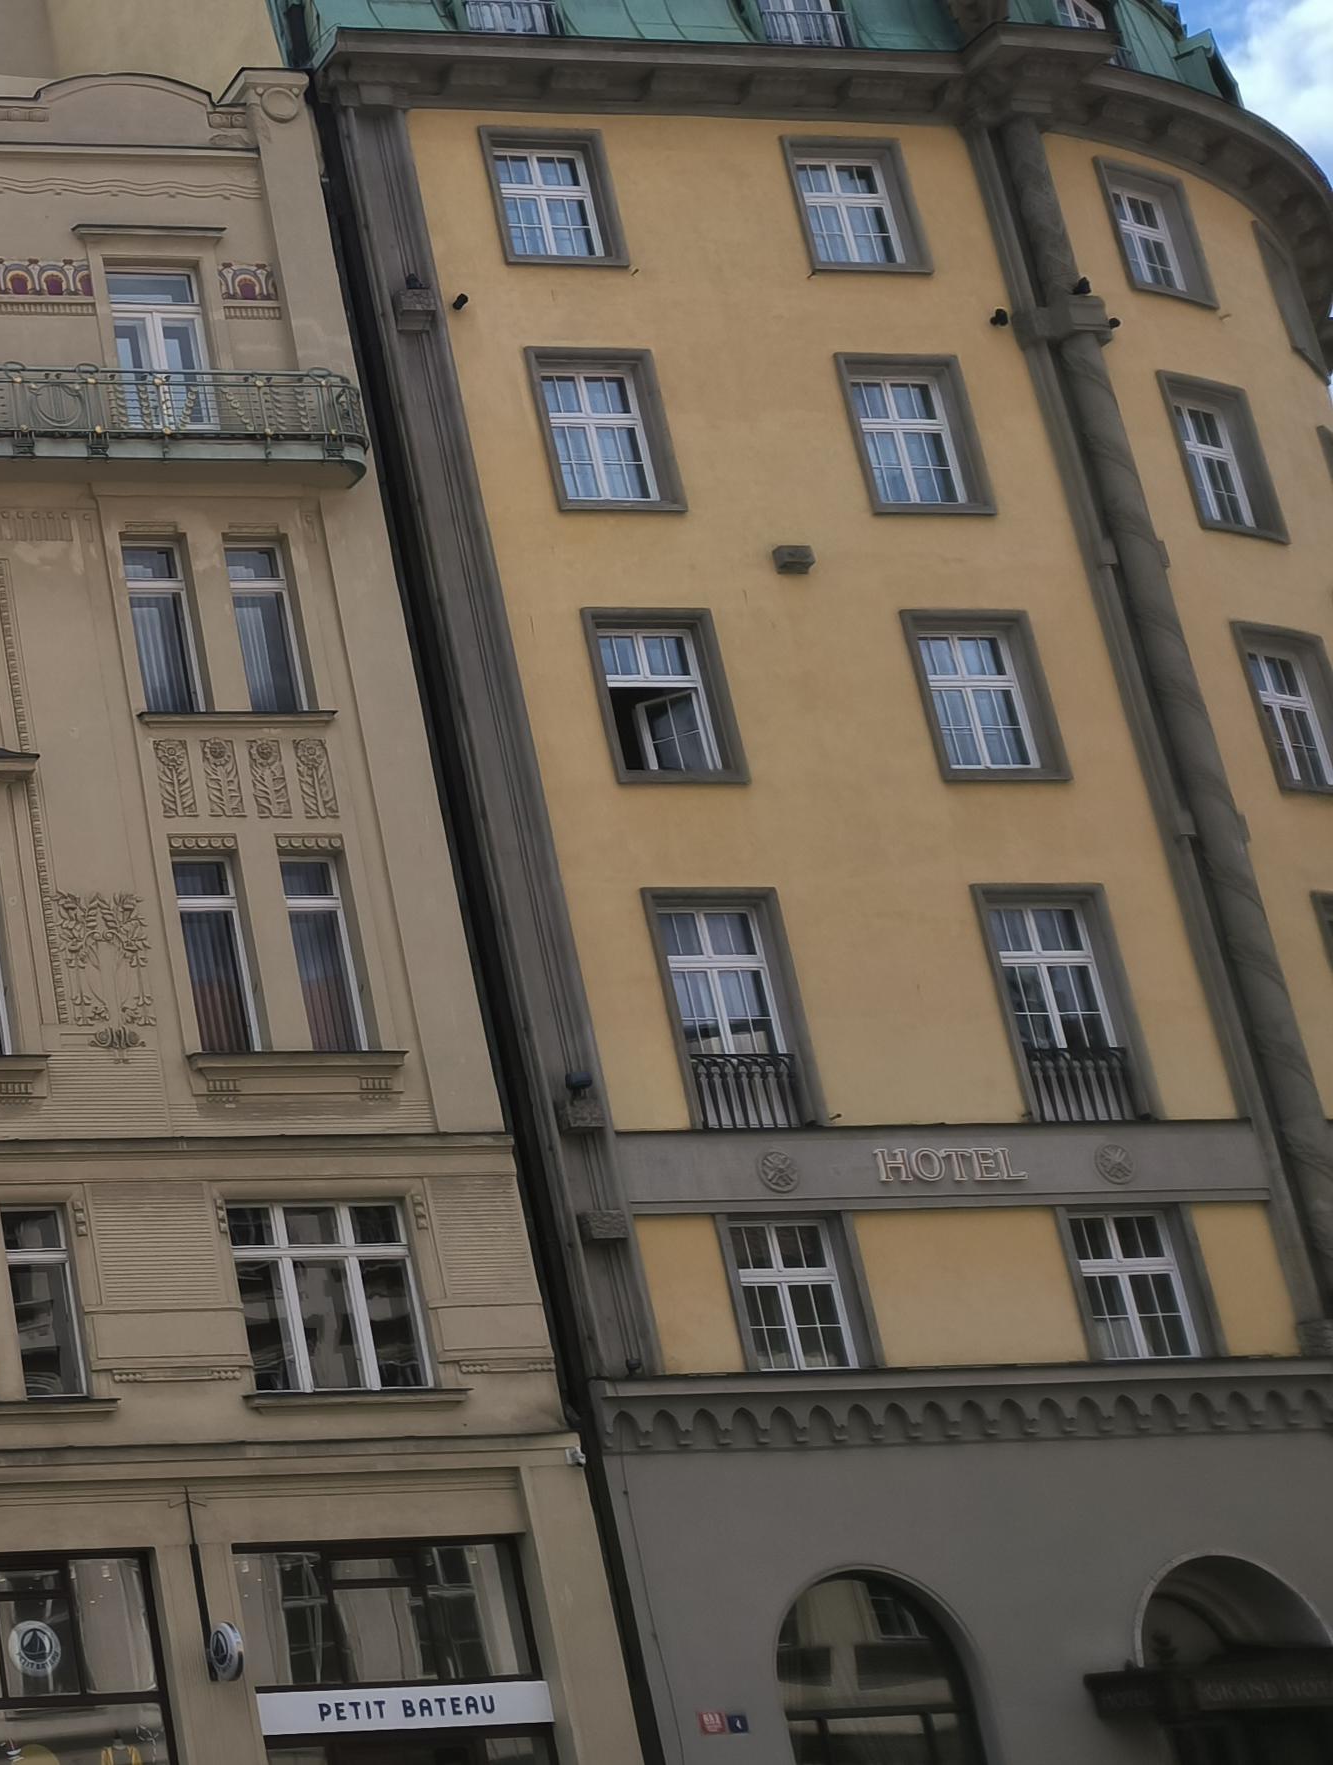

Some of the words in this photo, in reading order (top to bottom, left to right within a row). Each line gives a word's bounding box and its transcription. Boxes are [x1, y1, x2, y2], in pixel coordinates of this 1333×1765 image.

[873, 1147, 1028, 1182] HOTEL
[318, 1700, 386, 1722] PETIT
[402, 1694, 496, 1719] BATEAU
